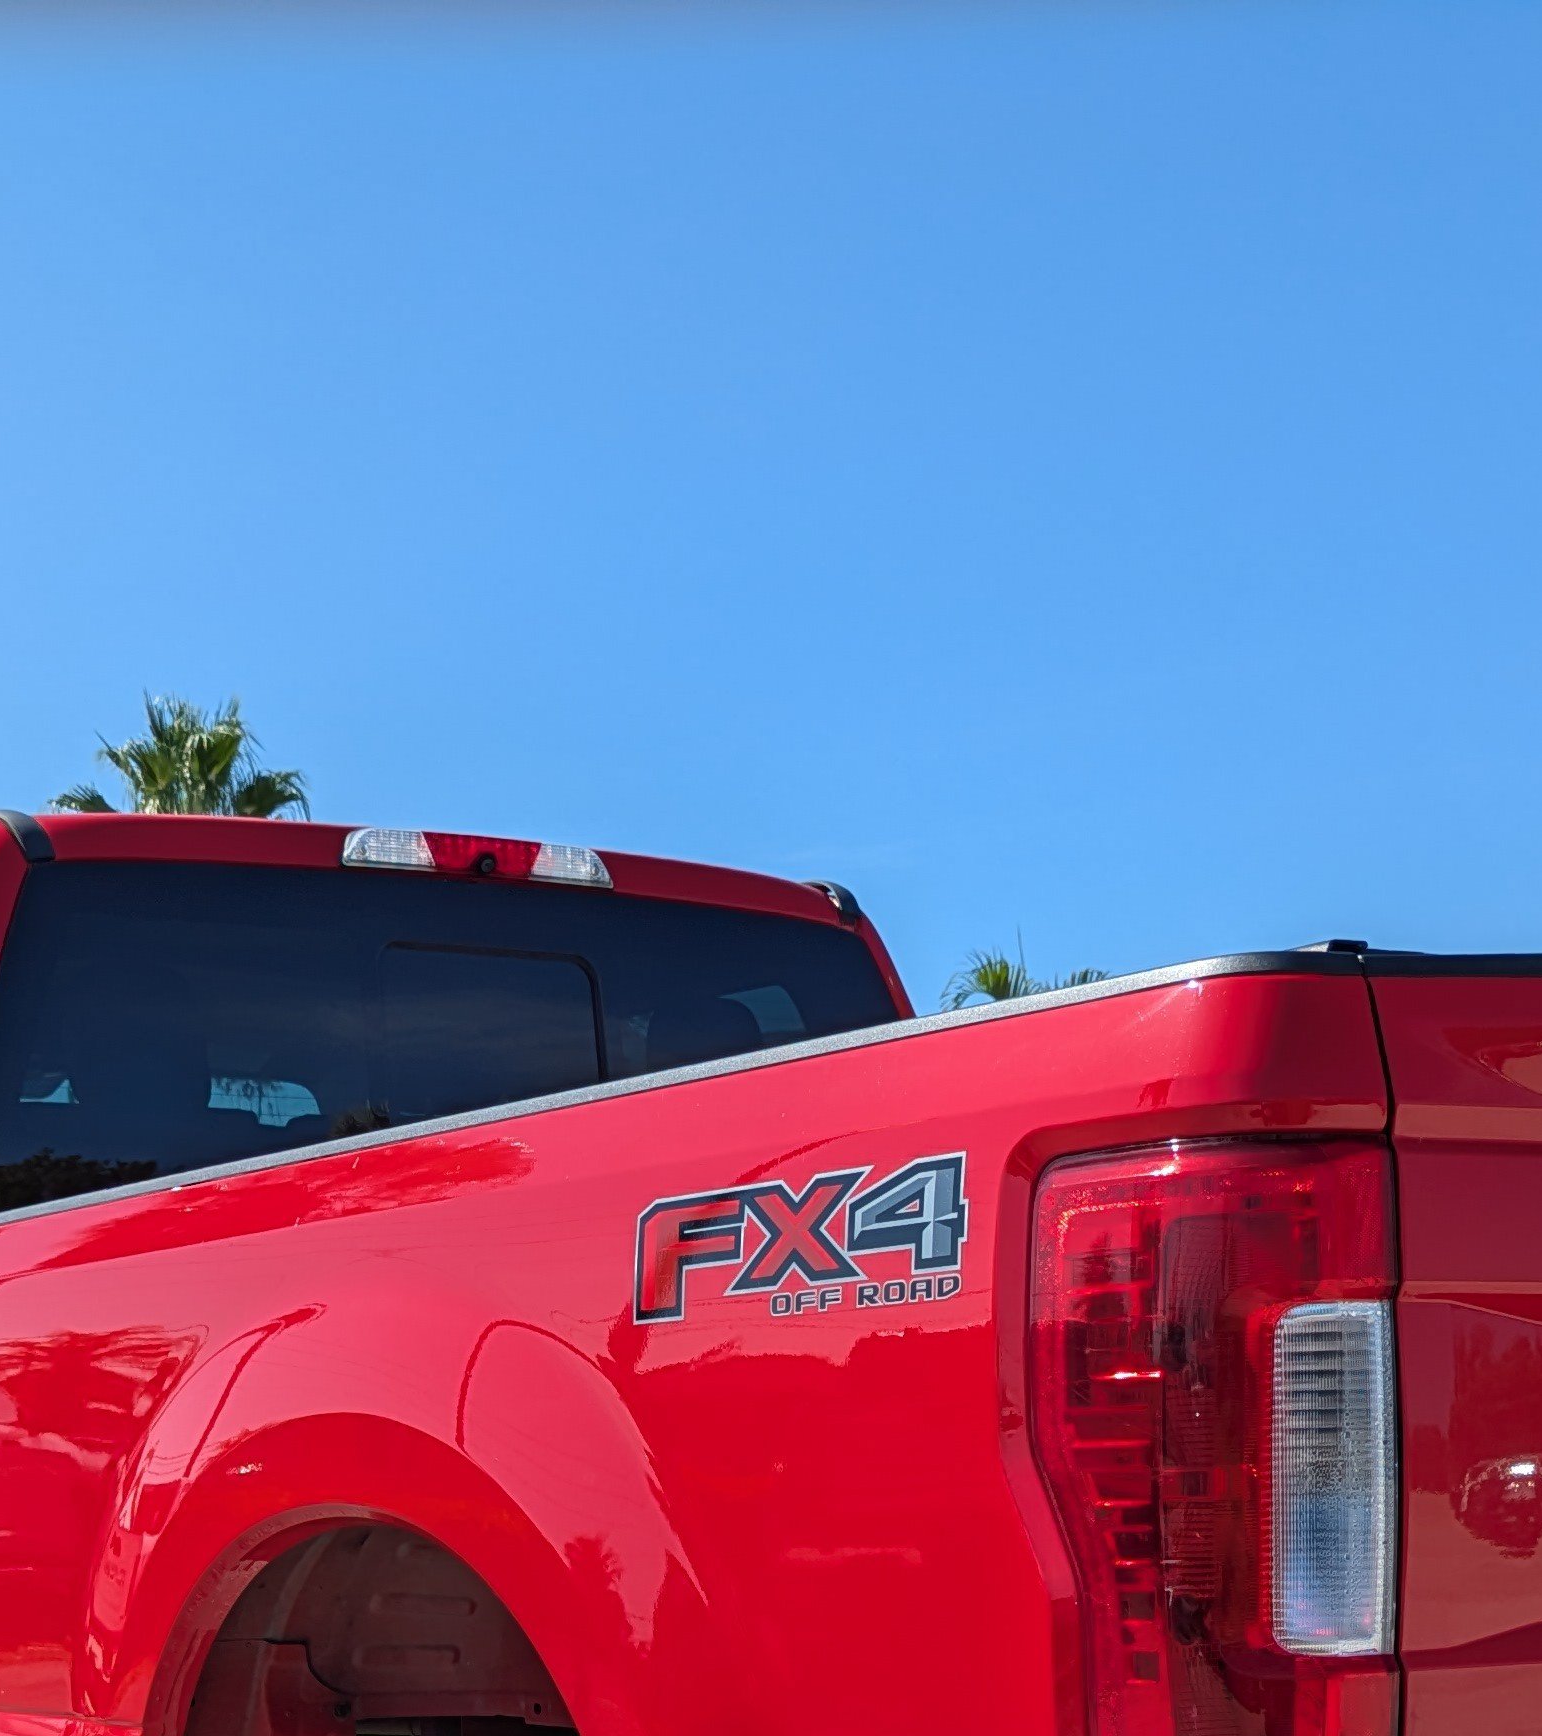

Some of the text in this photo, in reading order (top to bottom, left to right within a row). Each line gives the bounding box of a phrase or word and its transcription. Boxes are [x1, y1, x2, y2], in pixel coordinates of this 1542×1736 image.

[633, 1150, 970, 1325] FX4
[770, 1273, 962, 1317] OFF ROAD
